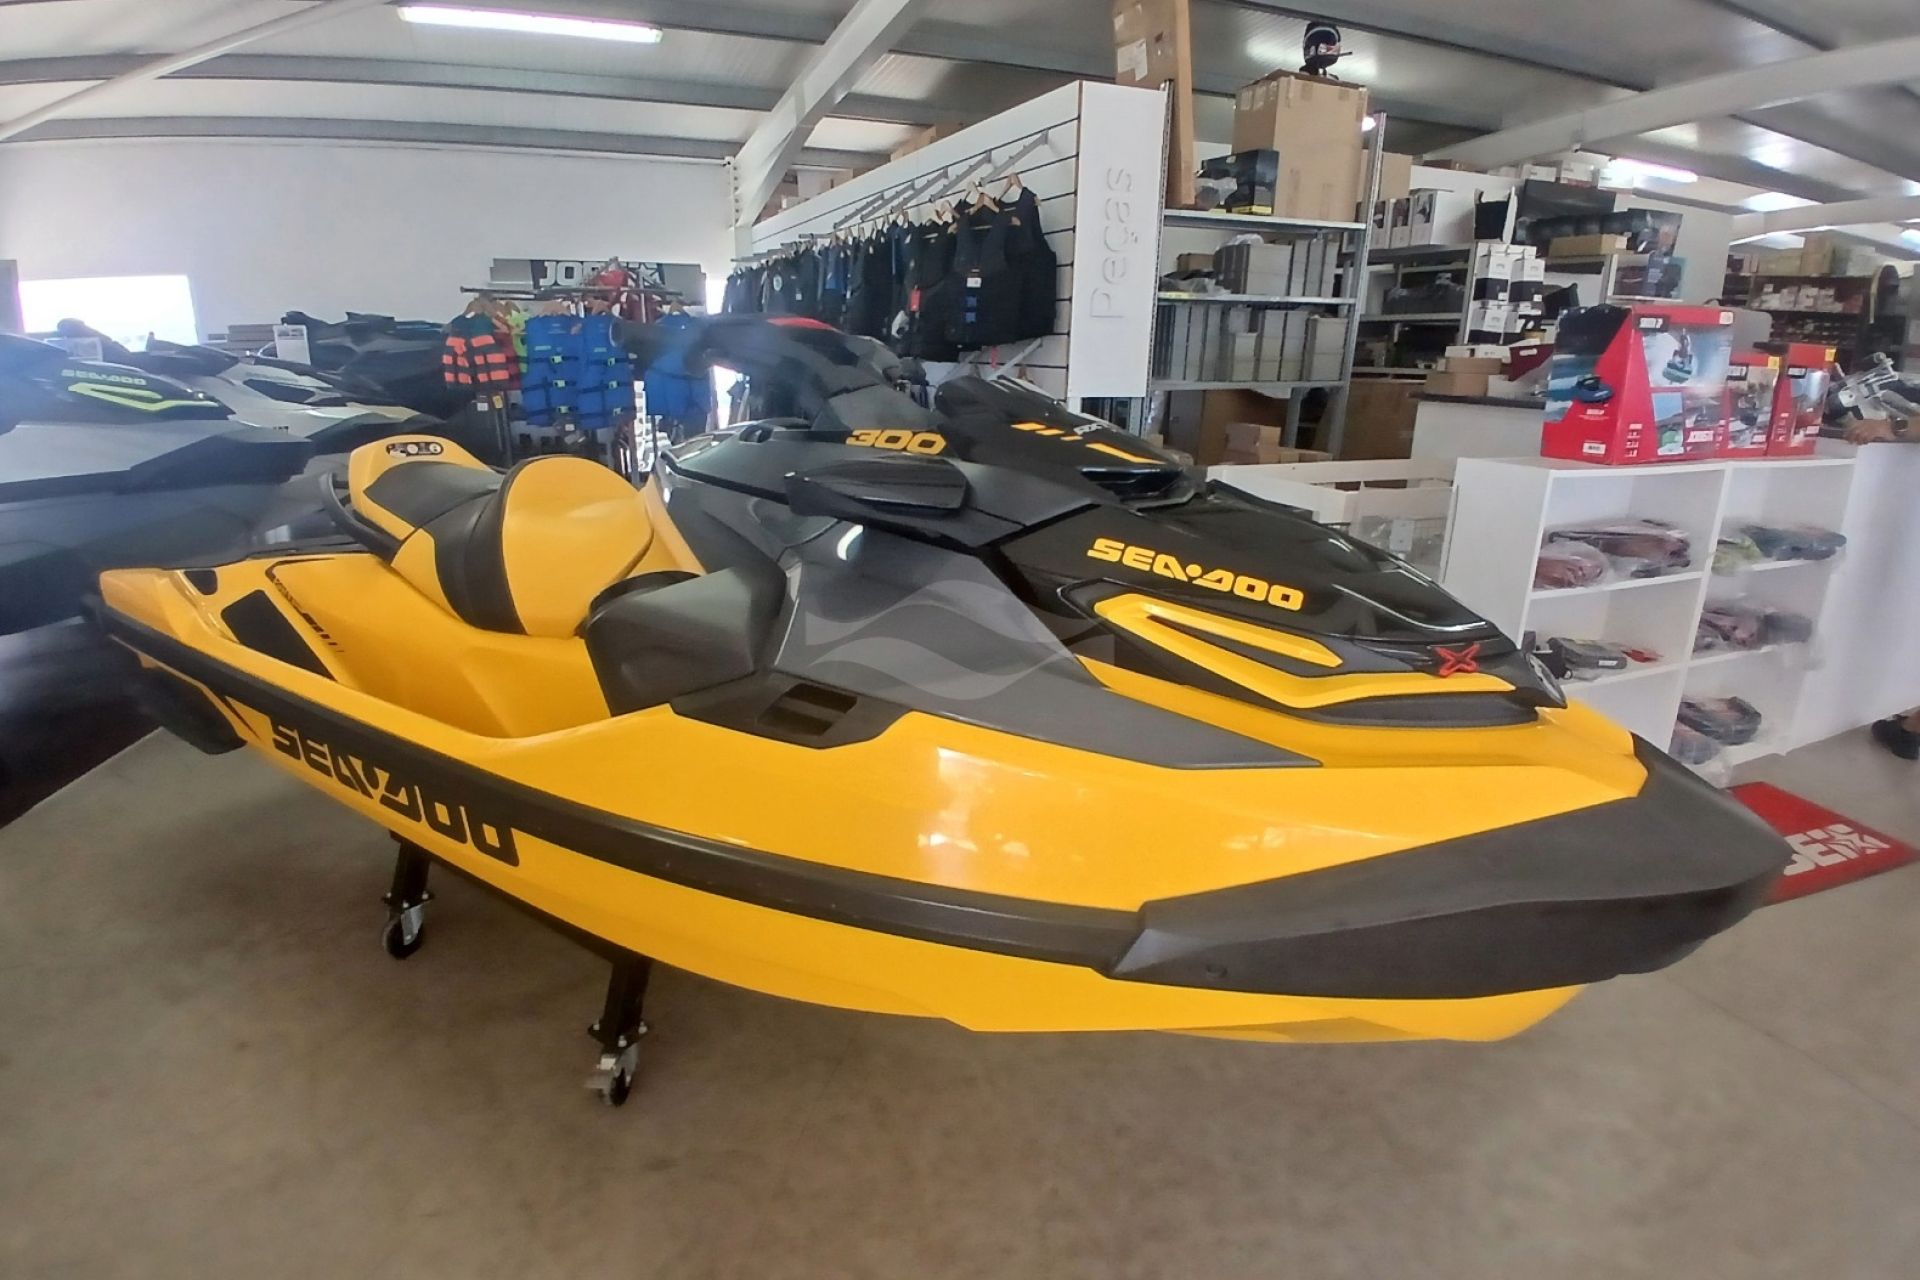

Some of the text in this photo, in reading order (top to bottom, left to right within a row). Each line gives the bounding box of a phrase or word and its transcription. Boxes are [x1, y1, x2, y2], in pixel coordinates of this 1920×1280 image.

[1089, 168, 1138, 319] Peças
[539, 260, 662, 287] JO
[845, 428, 947, 455] 300
